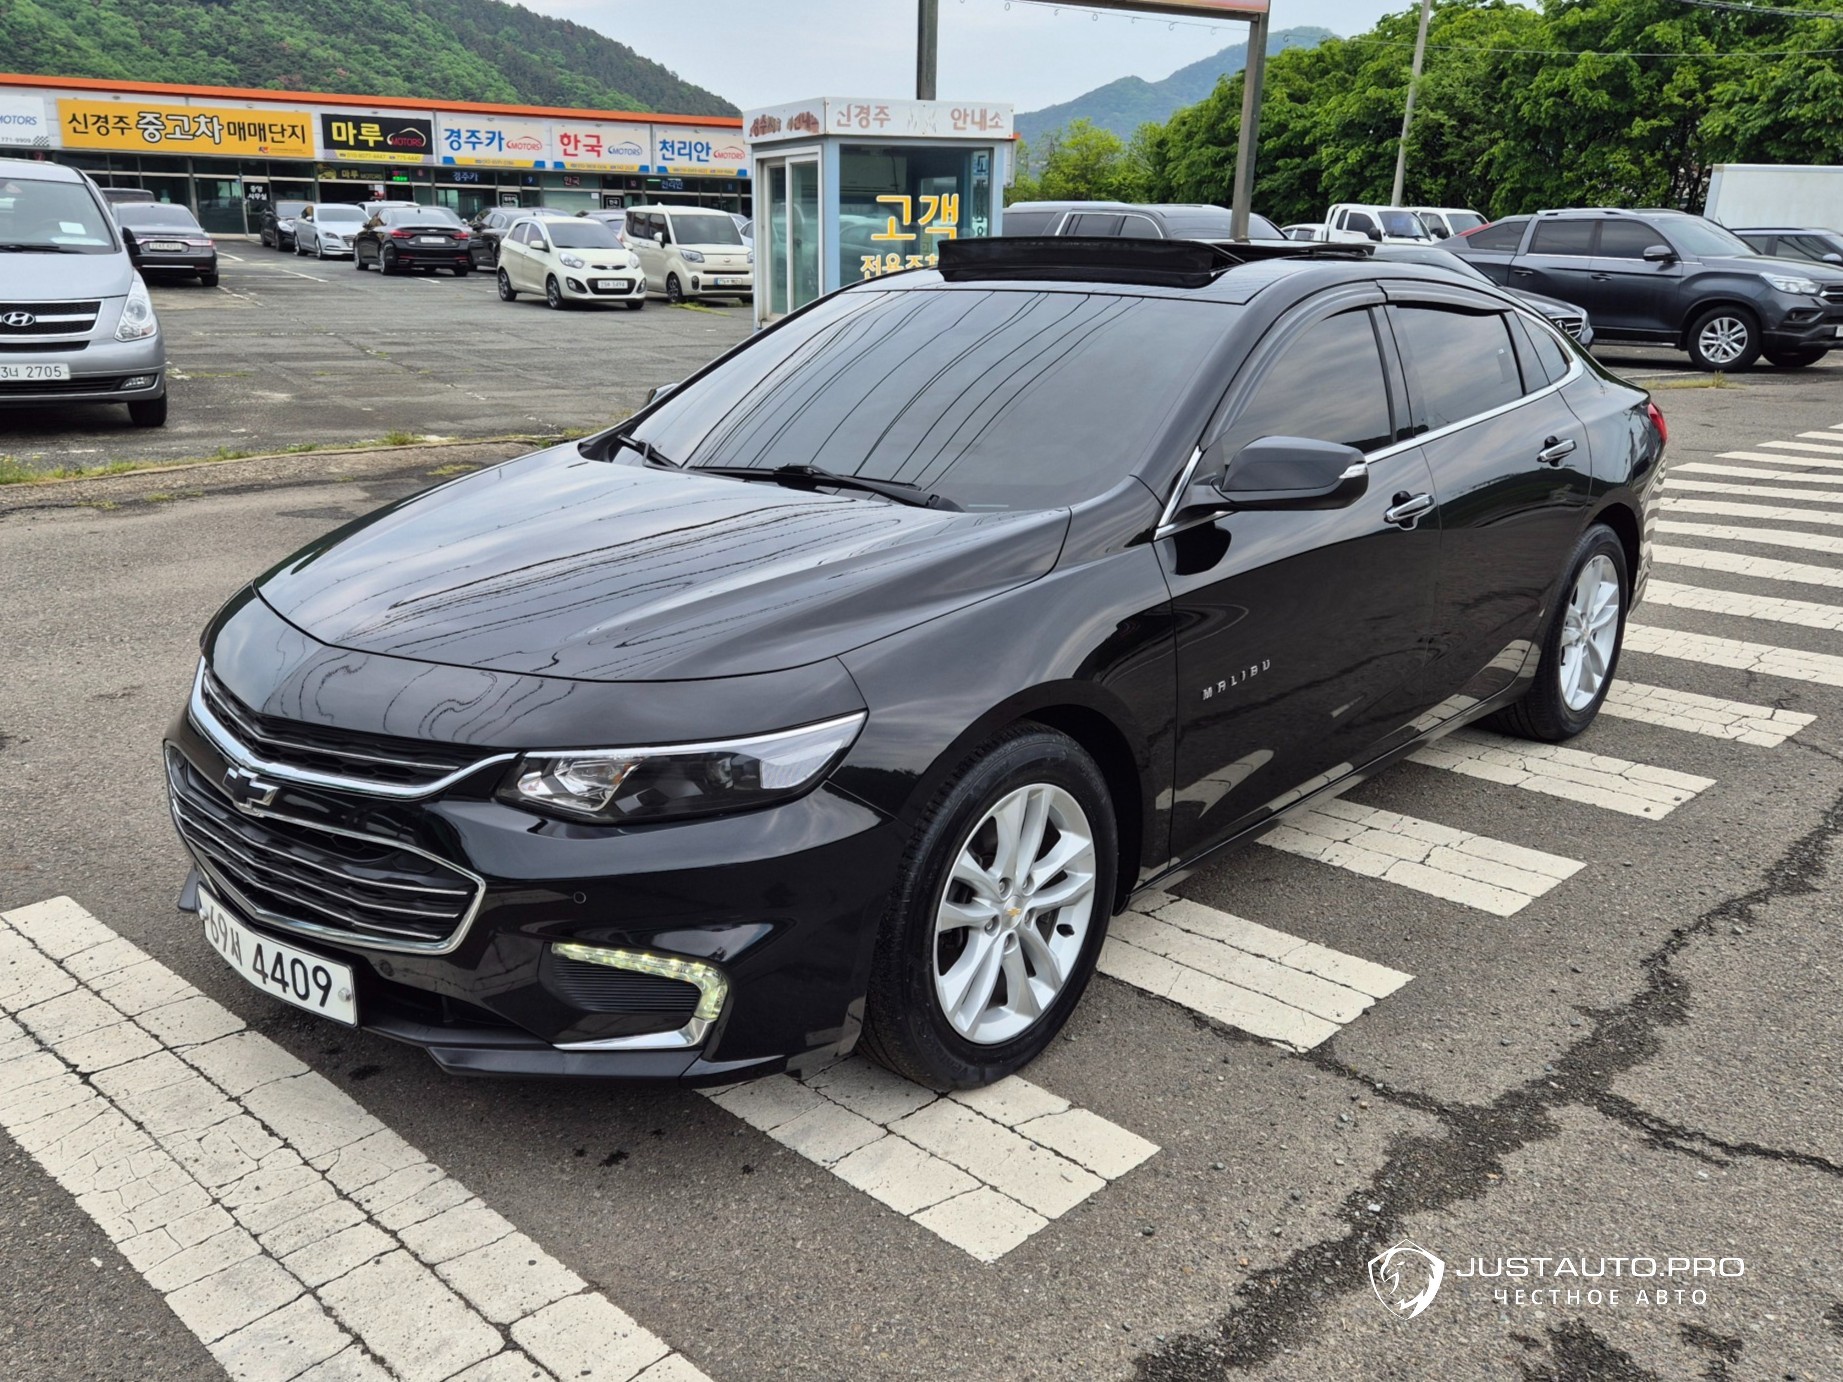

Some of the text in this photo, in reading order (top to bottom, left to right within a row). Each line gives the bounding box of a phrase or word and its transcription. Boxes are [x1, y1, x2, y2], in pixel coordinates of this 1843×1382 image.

[68, 111, 306, 145] 신경주 중고차 매매단지
[951, 108, 1004, 131] 안내소
[331, 121, 423, 147] 마루 MOTORS
[444, 128, 541, 152] 경주카 MOTORS
[560, 132, 640, 158] 한국 MOTORS
[658, 138, 745, 162] 천리안 MOTORS
[870, 193, 959, 240] 고객
[26, 366, 62, 378] 2705
[1202, 659, 1271, 700] MALIBU
[252, 943, 333, 1008] 4409
